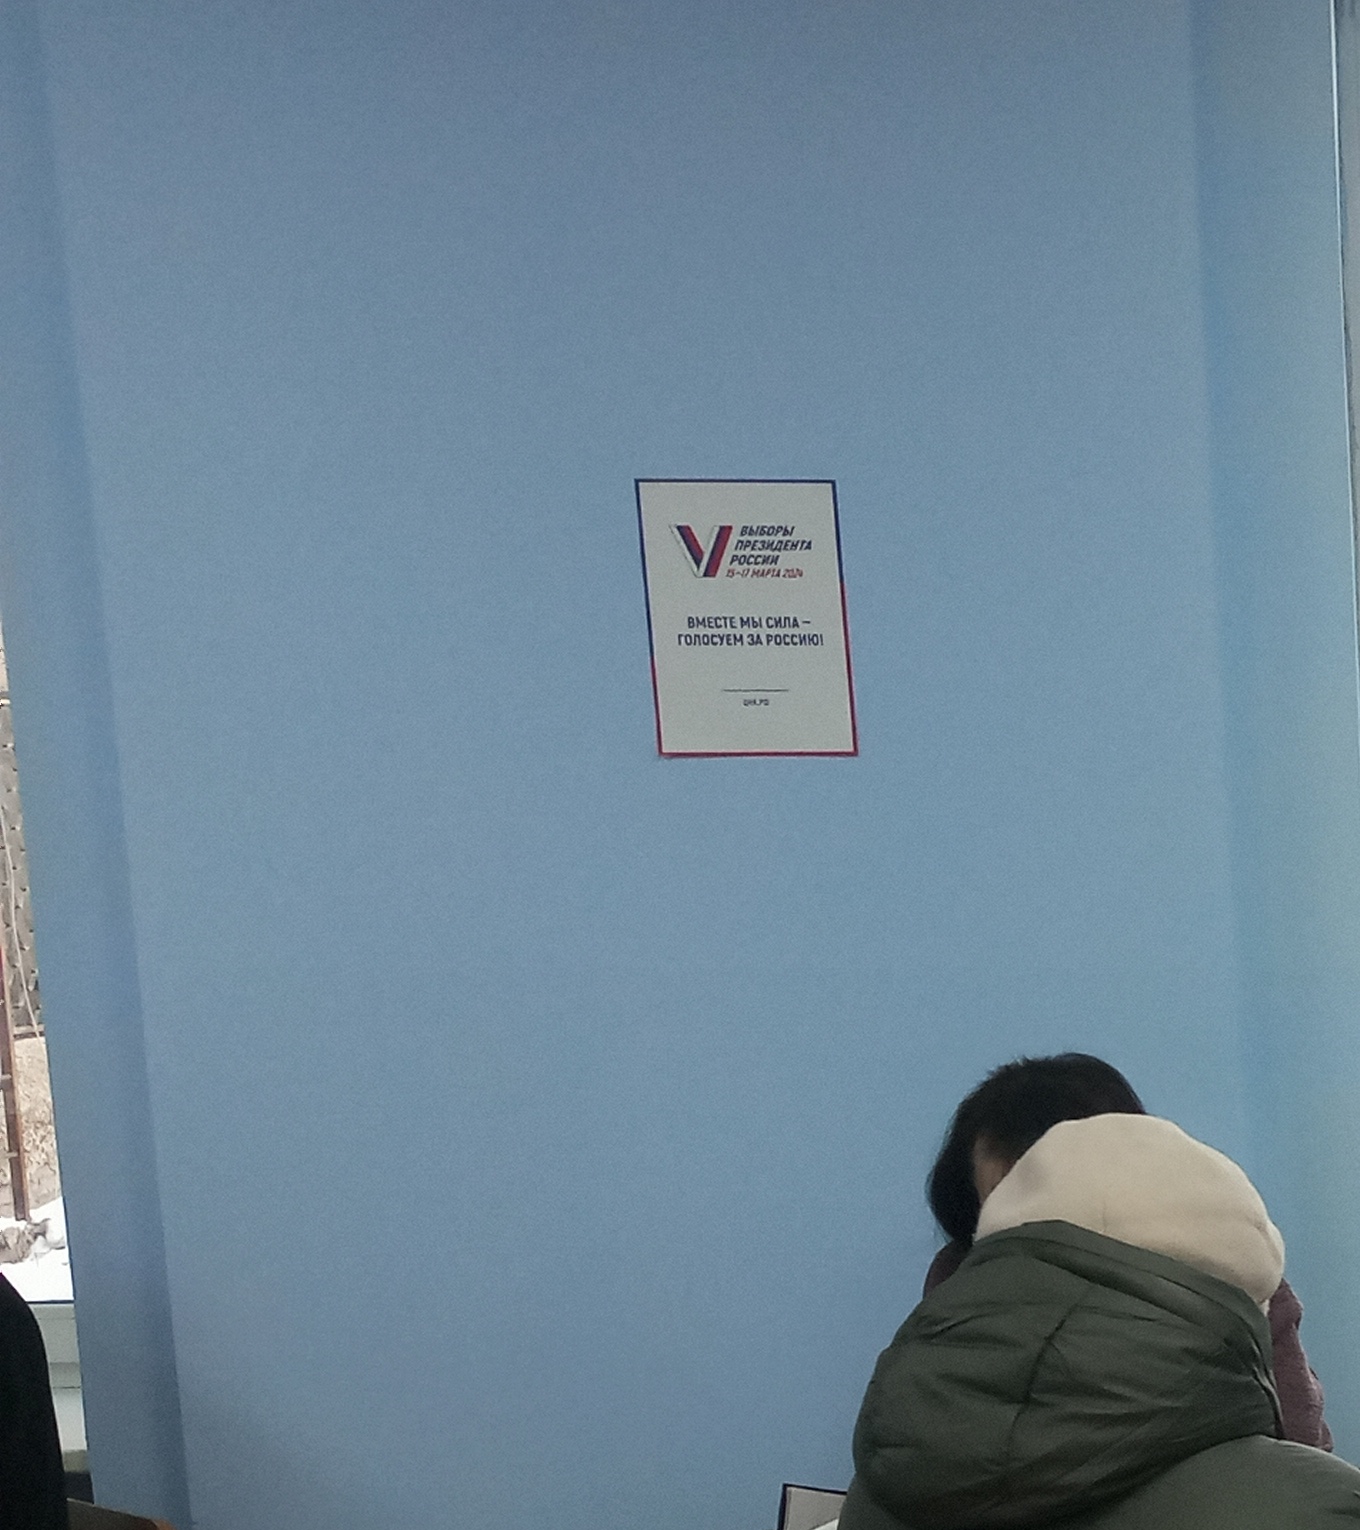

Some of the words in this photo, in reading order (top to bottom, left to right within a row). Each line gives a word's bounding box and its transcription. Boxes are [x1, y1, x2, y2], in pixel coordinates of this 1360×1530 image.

[740, 525, 795, 537] ВЫБОРЫ
[734, 540, 813, 552] ПРЕЗИДЕНТА
[729, 555, 780, 567] РОССИИ
[751, 568, 781, 578] МАРТА
[687, 616, 737, 629] ВМЕСТЕ
[740, 617, 762, 629] МЫ
[765, 617, 800, 629] СИЛА
[677, 634, 744, 646] ГОЛОСУЕМ
[747, 634, 763, 646] ЗА
[766, 634, 824, 646] РОССИЮ!
